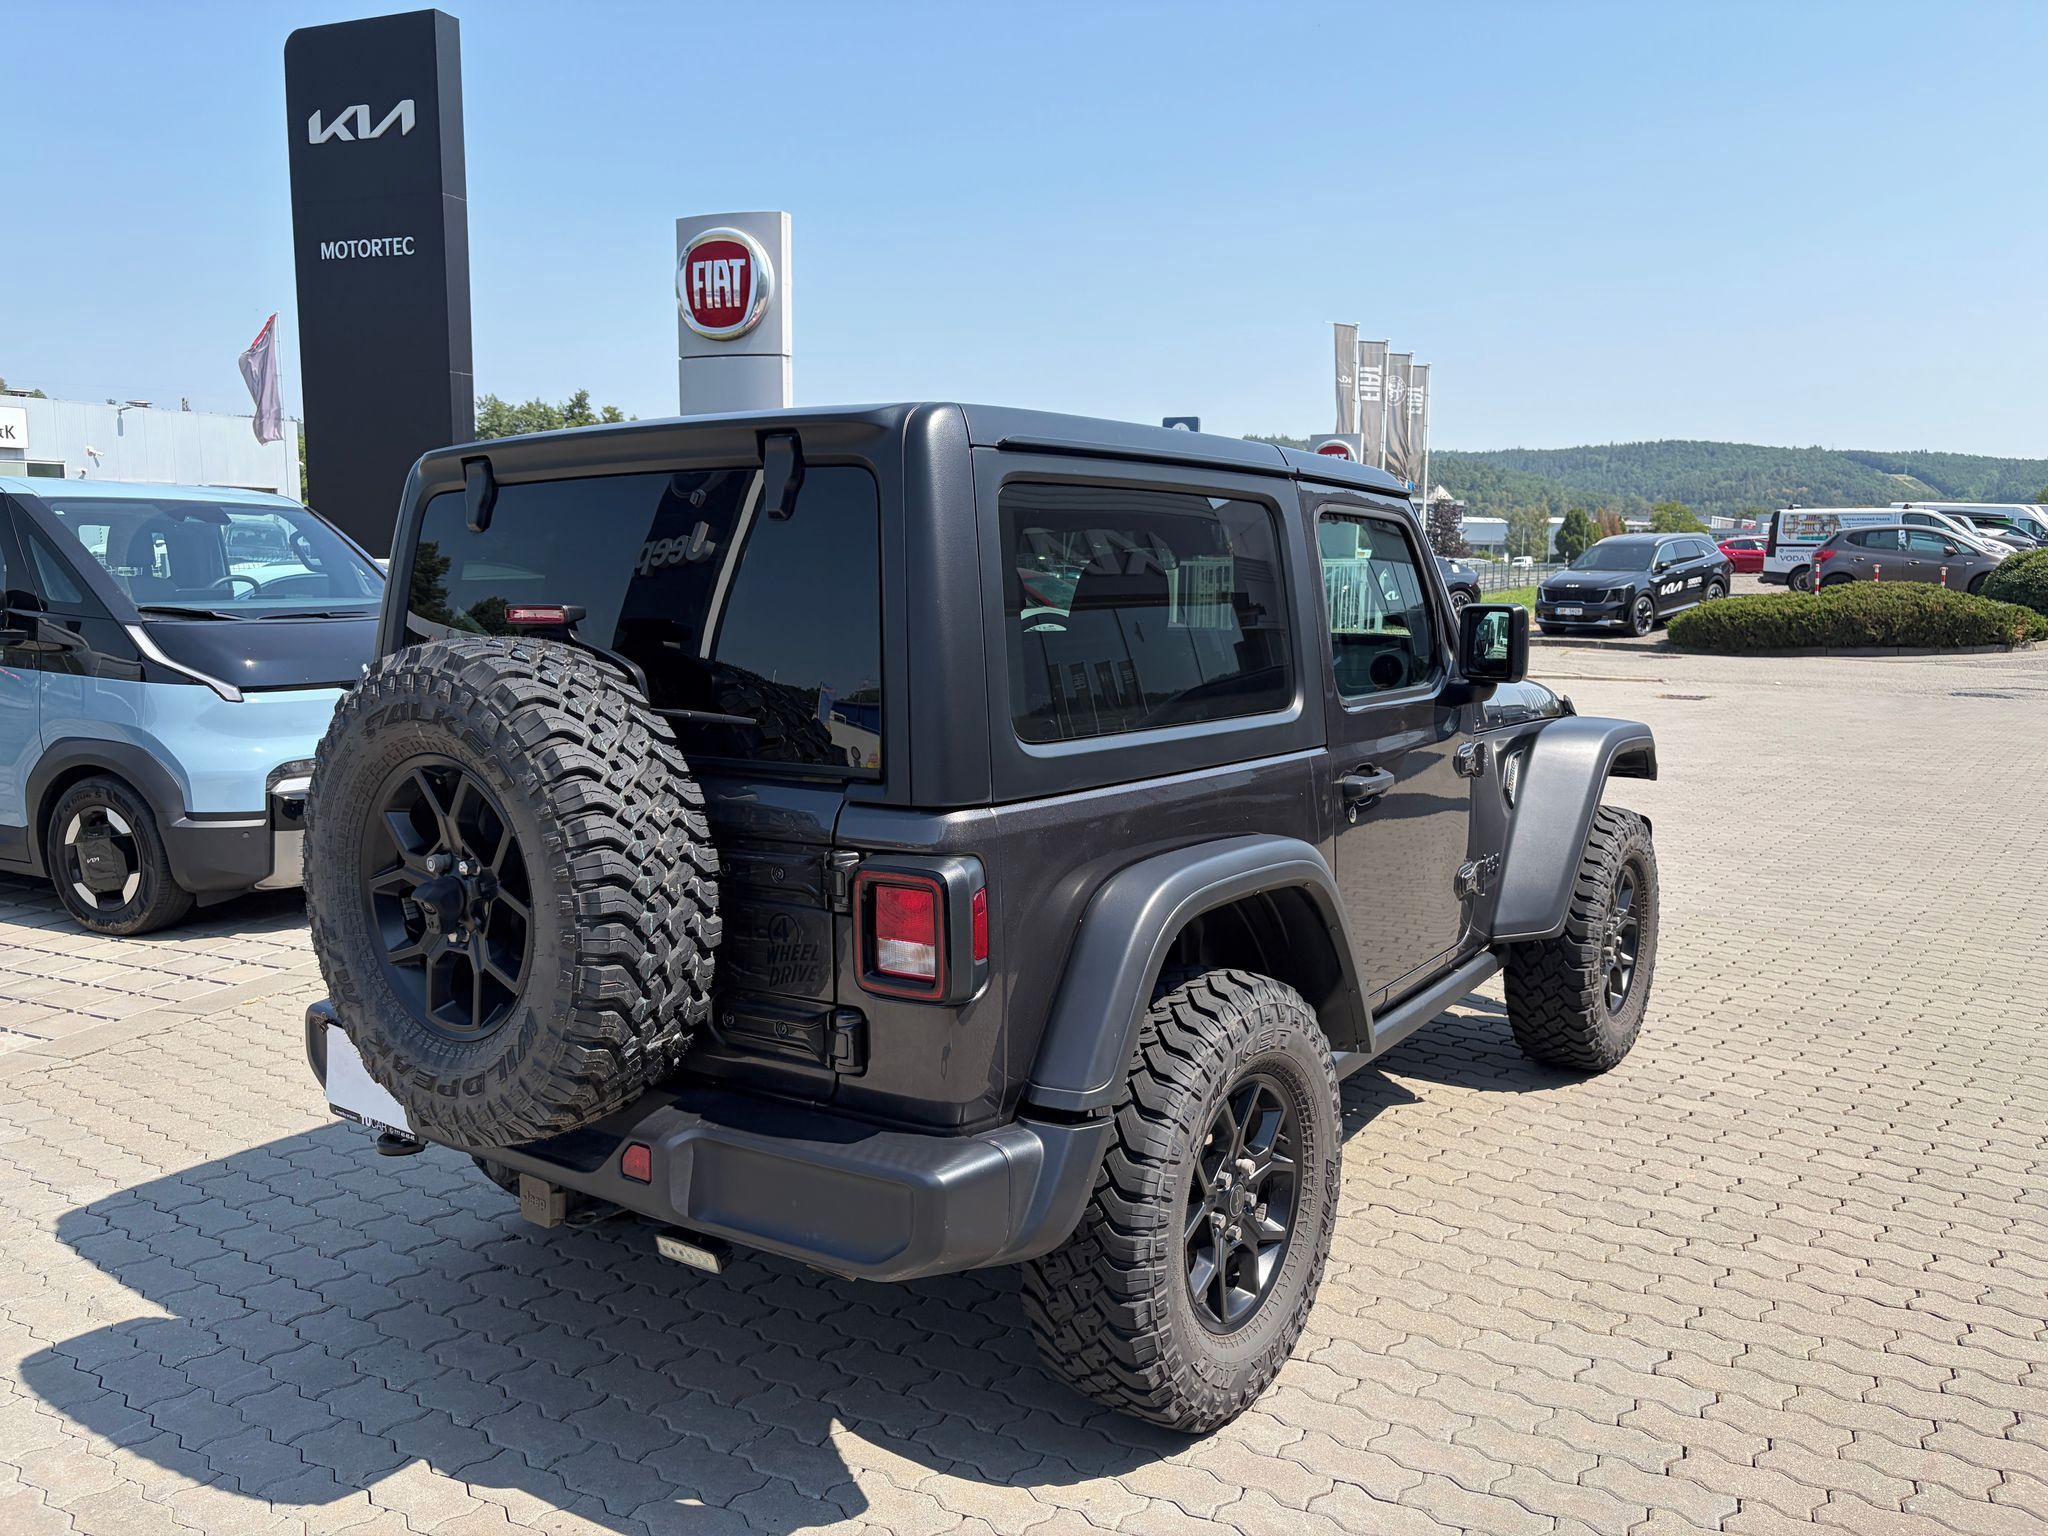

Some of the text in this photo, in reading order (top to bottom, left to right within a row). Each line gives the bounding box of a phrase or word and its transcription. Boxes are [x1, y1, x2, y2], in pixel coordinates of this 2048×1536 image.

[308, 99, 415, 144] KIA
[320, 236, 415, 260] MOTORTEC
[692, 258, 746, 310] FIAT
[1660, 580, 1683, 596] KIA
[767, 943, 820, 964] WHEEL
[768, 964, 819, 987] DRIVE
